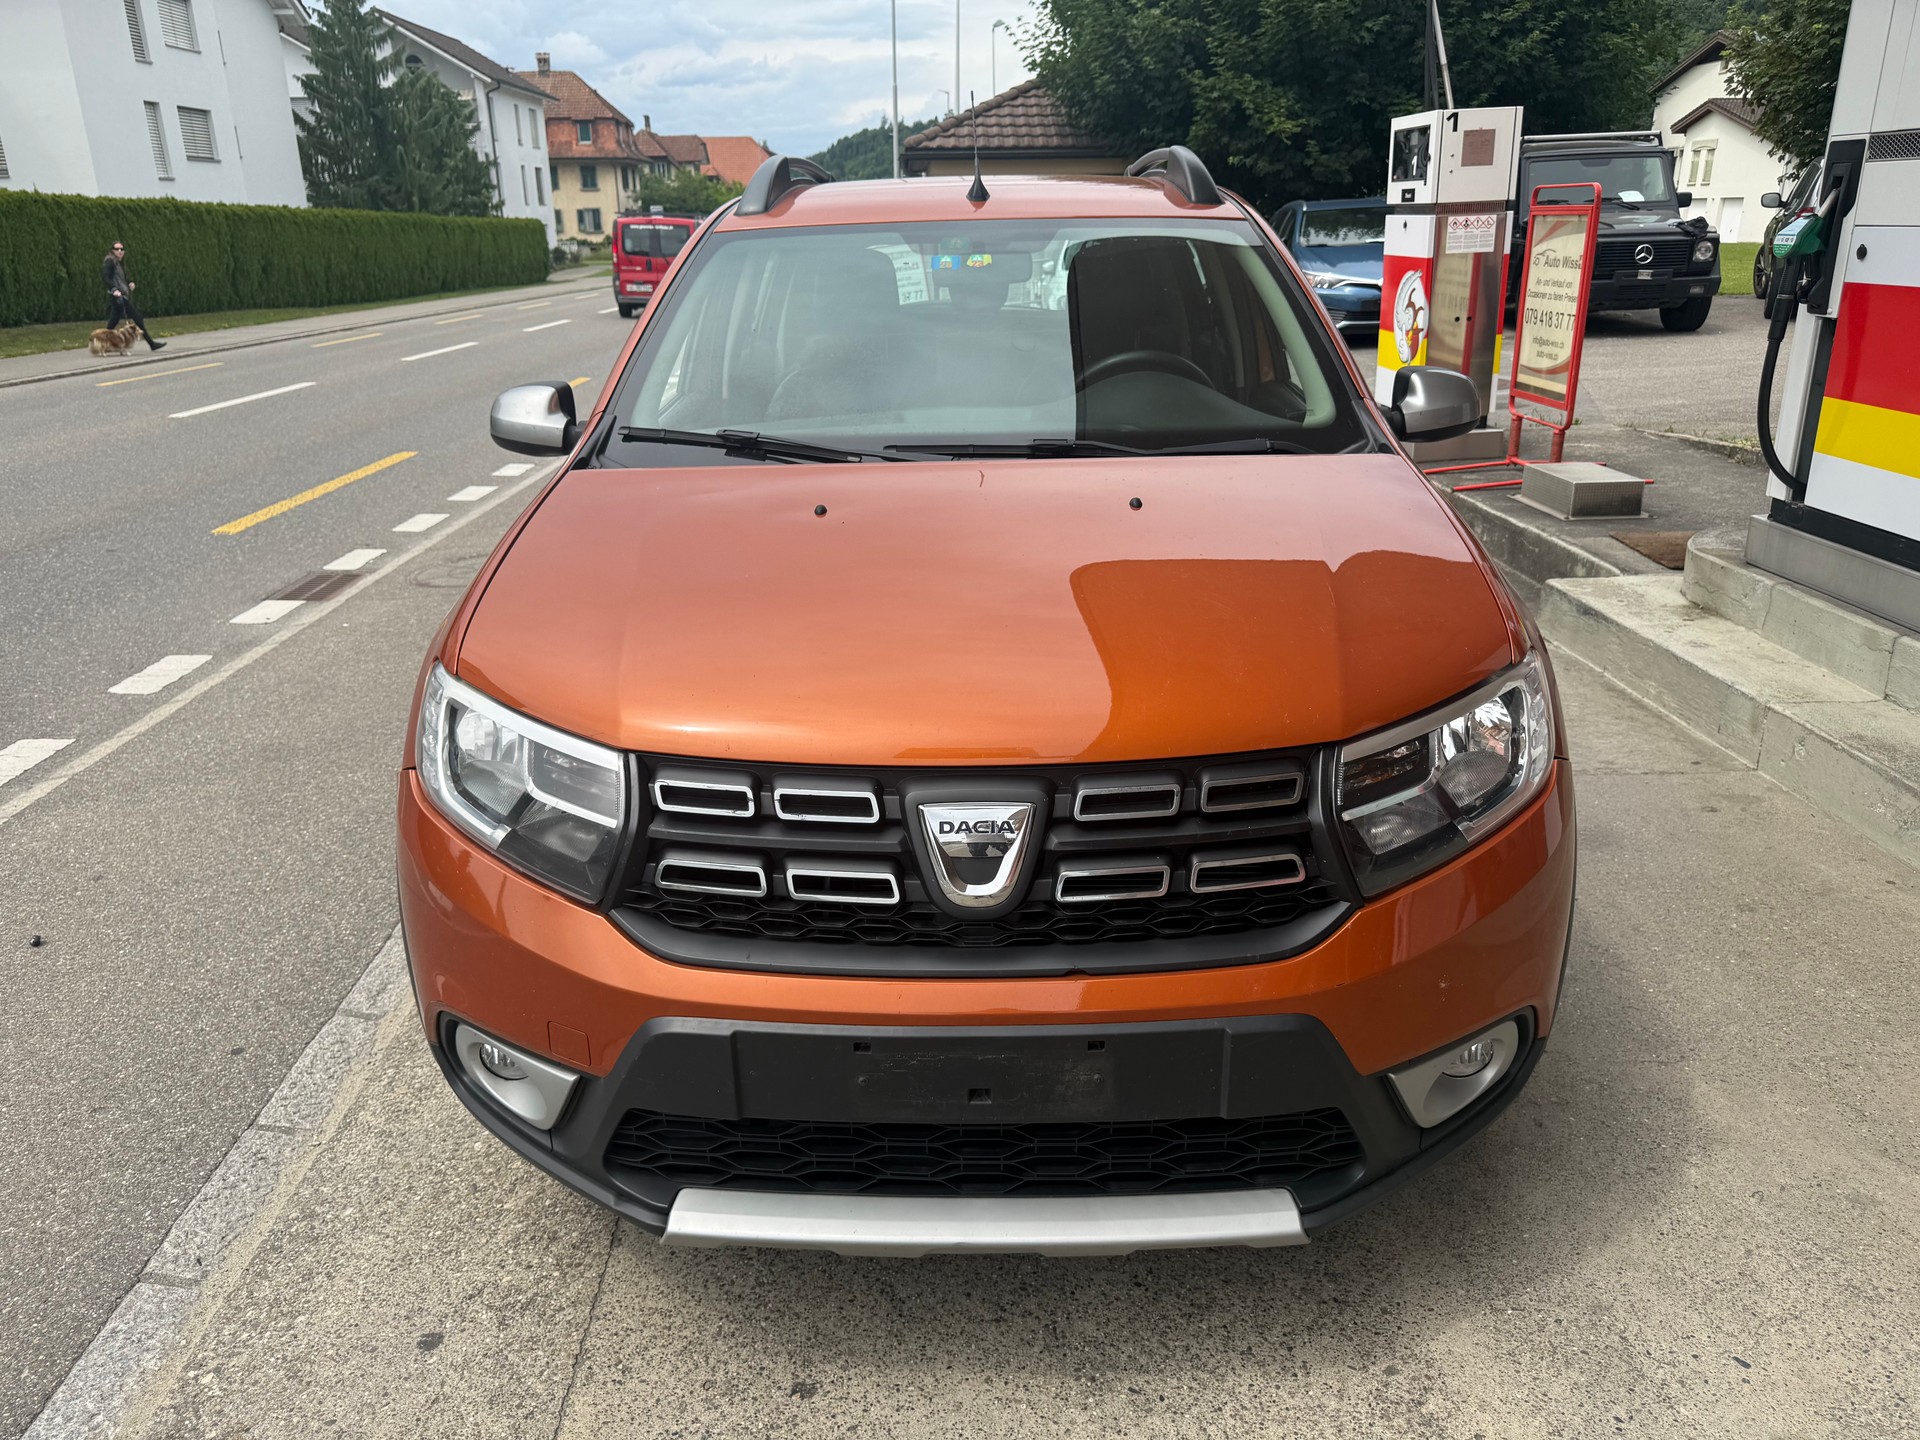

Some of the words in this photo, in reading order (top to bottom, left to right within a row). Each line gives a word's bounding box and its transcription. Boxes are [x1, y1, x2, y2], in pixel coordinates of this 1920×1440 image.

[1446, 112, 1459, 132] 1
[1411, 155, 1418, 176] 1
[1544, 255, 1561, 268] Auto
[1562, 255, 1577, 269] Wiss
[1564, 292, 1578, 303] Preise
[1524, 308, 1538, 325] 079
[1538, 309, 1553, 328] 418
[1554, 311, 1565, 329] 37
[1566, 313, 1576, 331] 77
[938, 820, 1016, 835] DACIA
